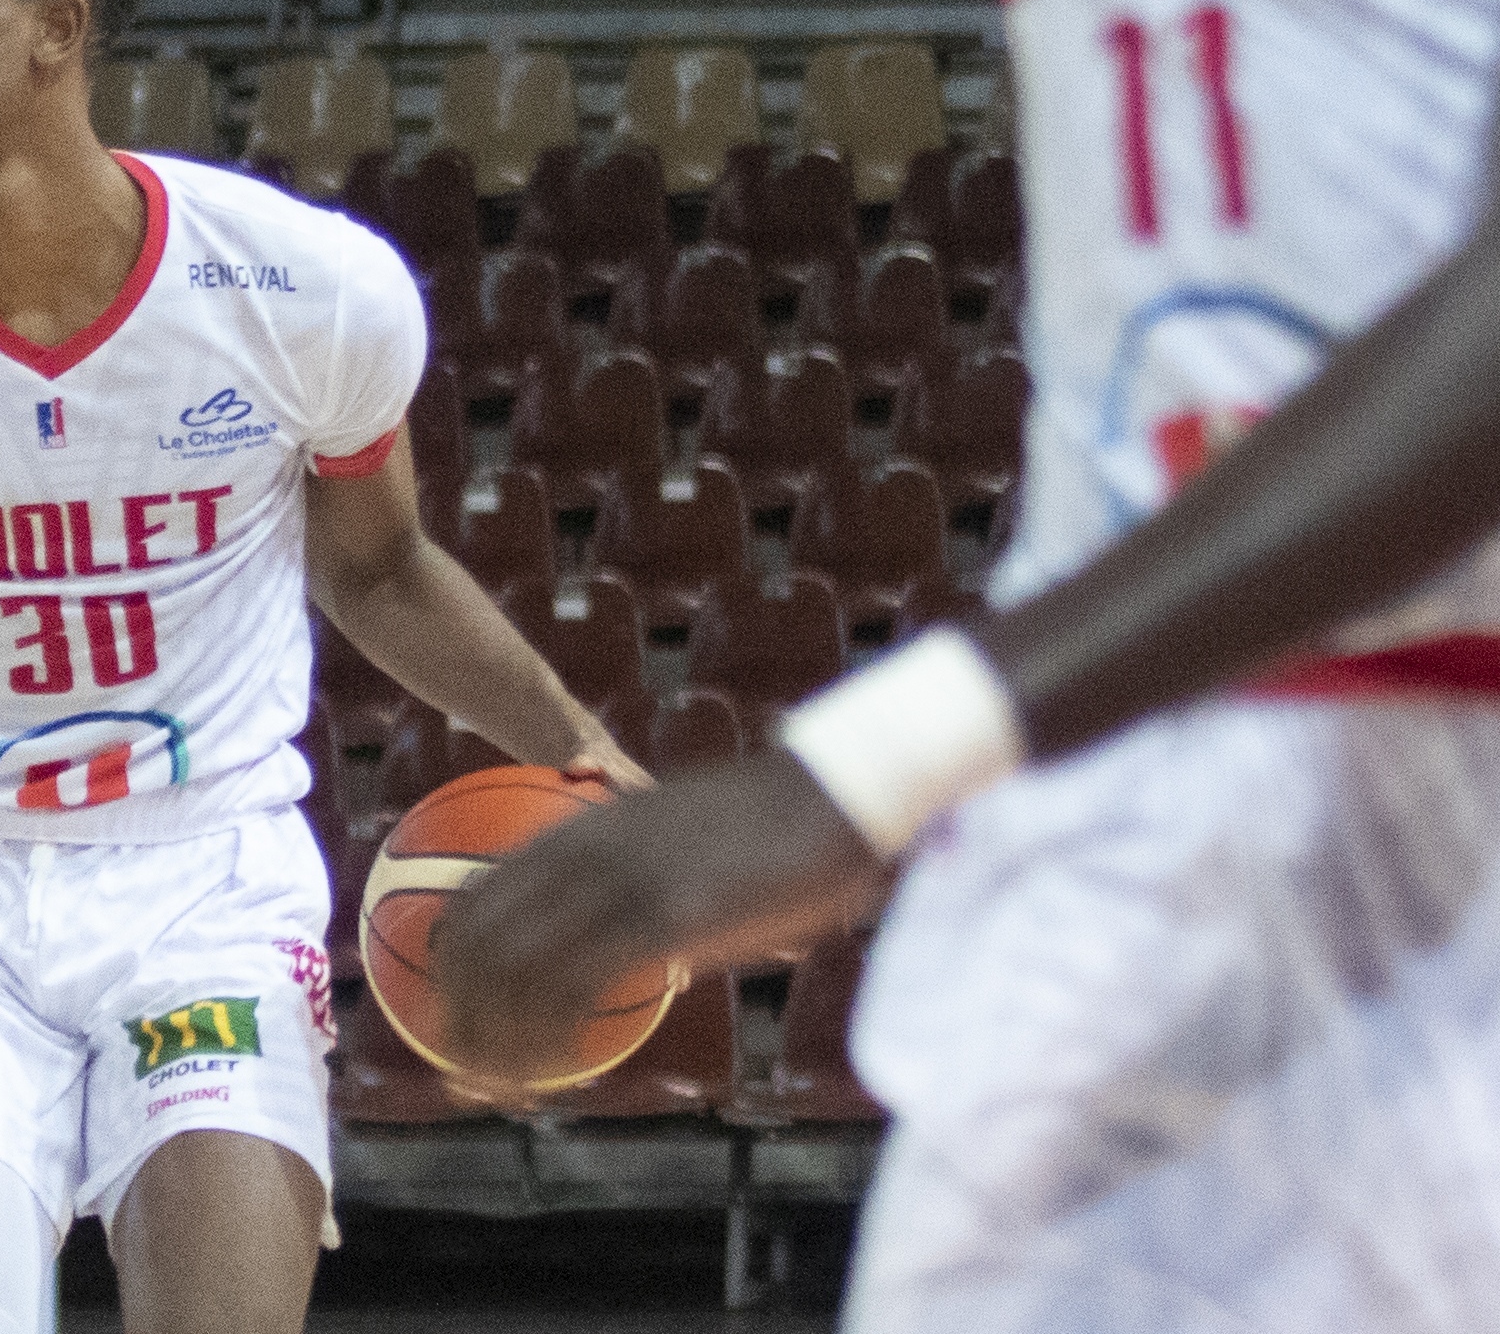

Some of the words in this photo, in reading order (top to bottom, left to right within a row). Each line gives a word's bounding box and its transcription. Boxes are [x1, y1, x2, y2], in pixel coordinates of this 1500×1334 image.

[1106, 2, 1252, 244] 11
[157, 433, 184, 451] Le
[147, 1058, 239, 1089] CHOLET
